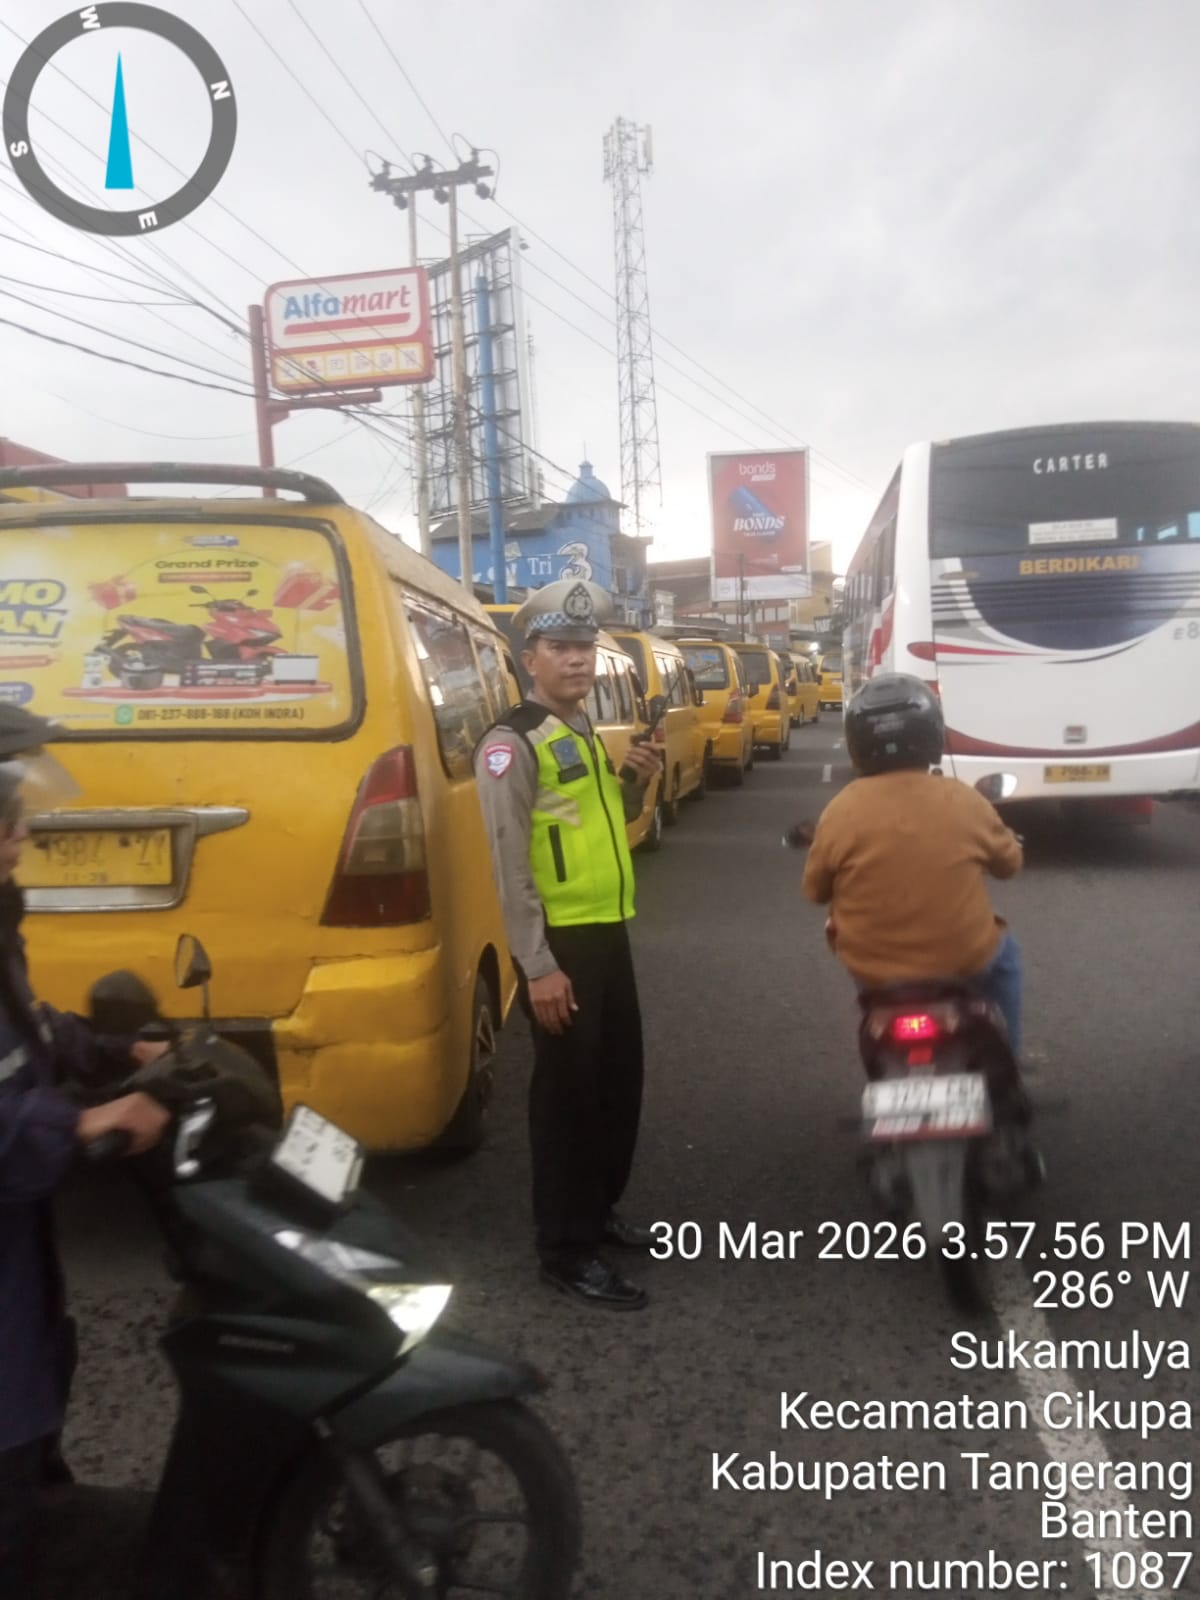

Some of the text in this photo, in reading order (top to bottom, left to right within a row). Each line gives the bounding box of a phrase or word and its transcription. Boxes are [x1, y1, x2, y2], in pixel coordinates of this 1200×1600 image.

[283, 285, 412, 320] Alfamart
[738, 461, 776, 476] bonds
[1033, 453, 1109, 474] CARTER
[733, 515, 785, 532] BONDS
[155, 558, 259, 569] Grand Prize
[527, 556, 553, 576] Tri
[1018, 555, 1140, 576] BERDIKARI
